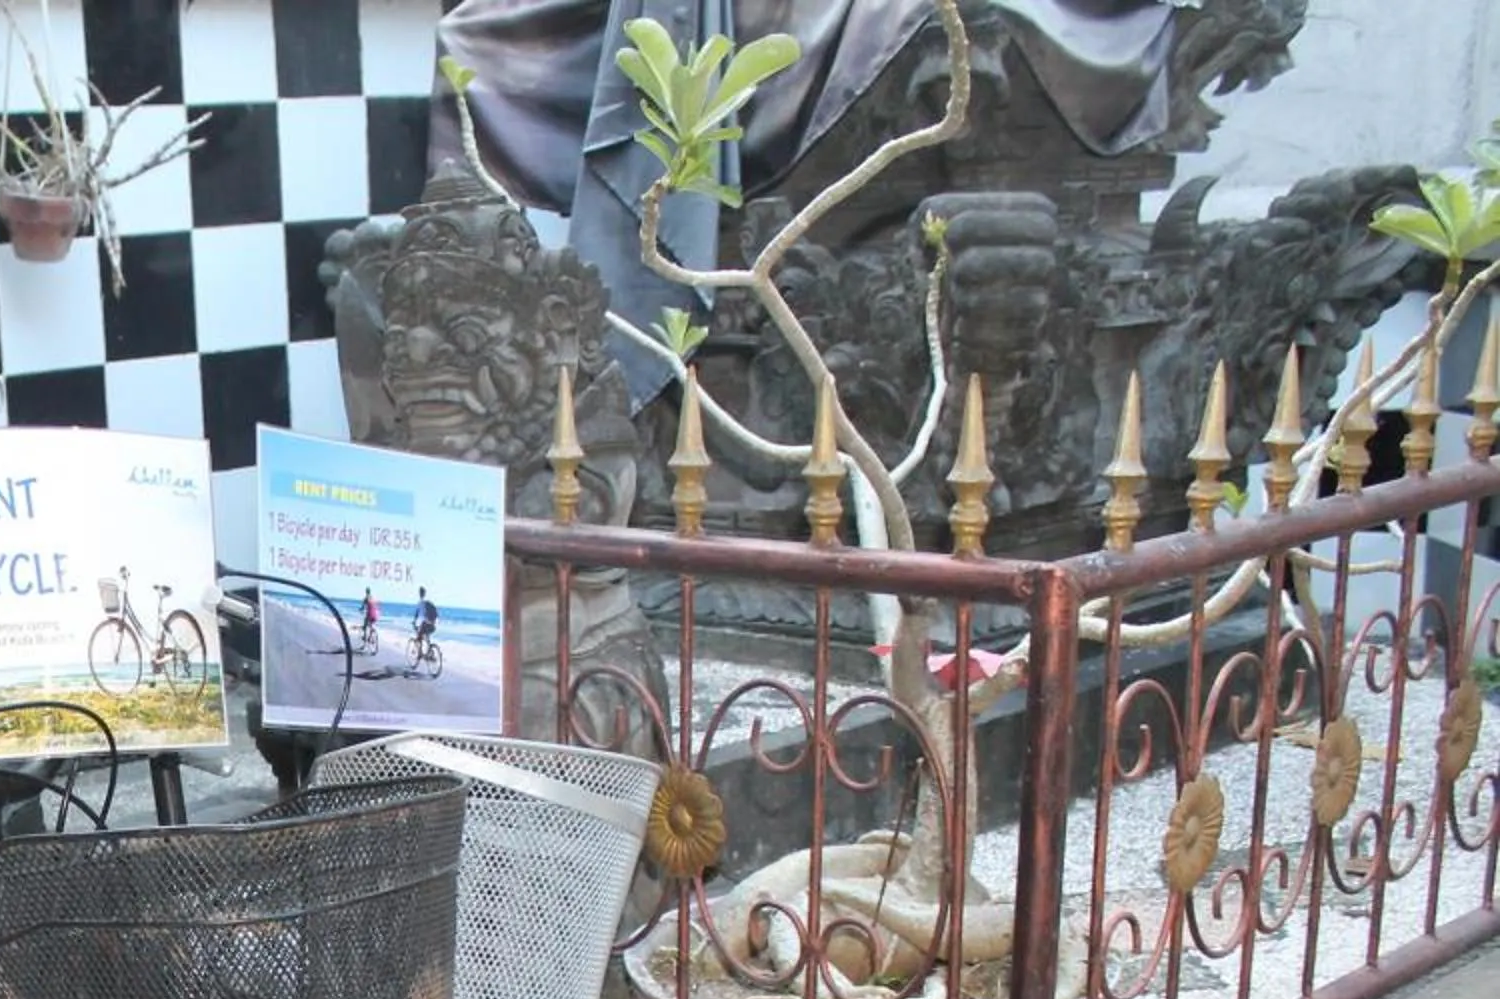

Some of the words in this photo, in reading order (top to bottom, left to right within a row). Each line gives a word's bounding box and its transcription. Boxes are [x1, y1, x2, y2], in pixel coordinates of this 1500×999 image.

[277, 512, 316, 541] Bicycle
[318, 524, 337, 547] per
[338, 519, 361, 548] day
[277, 547, 316, 575] Bicycle
[318, 558, 337, 581] per
[339, 555, 366, 578] hour
